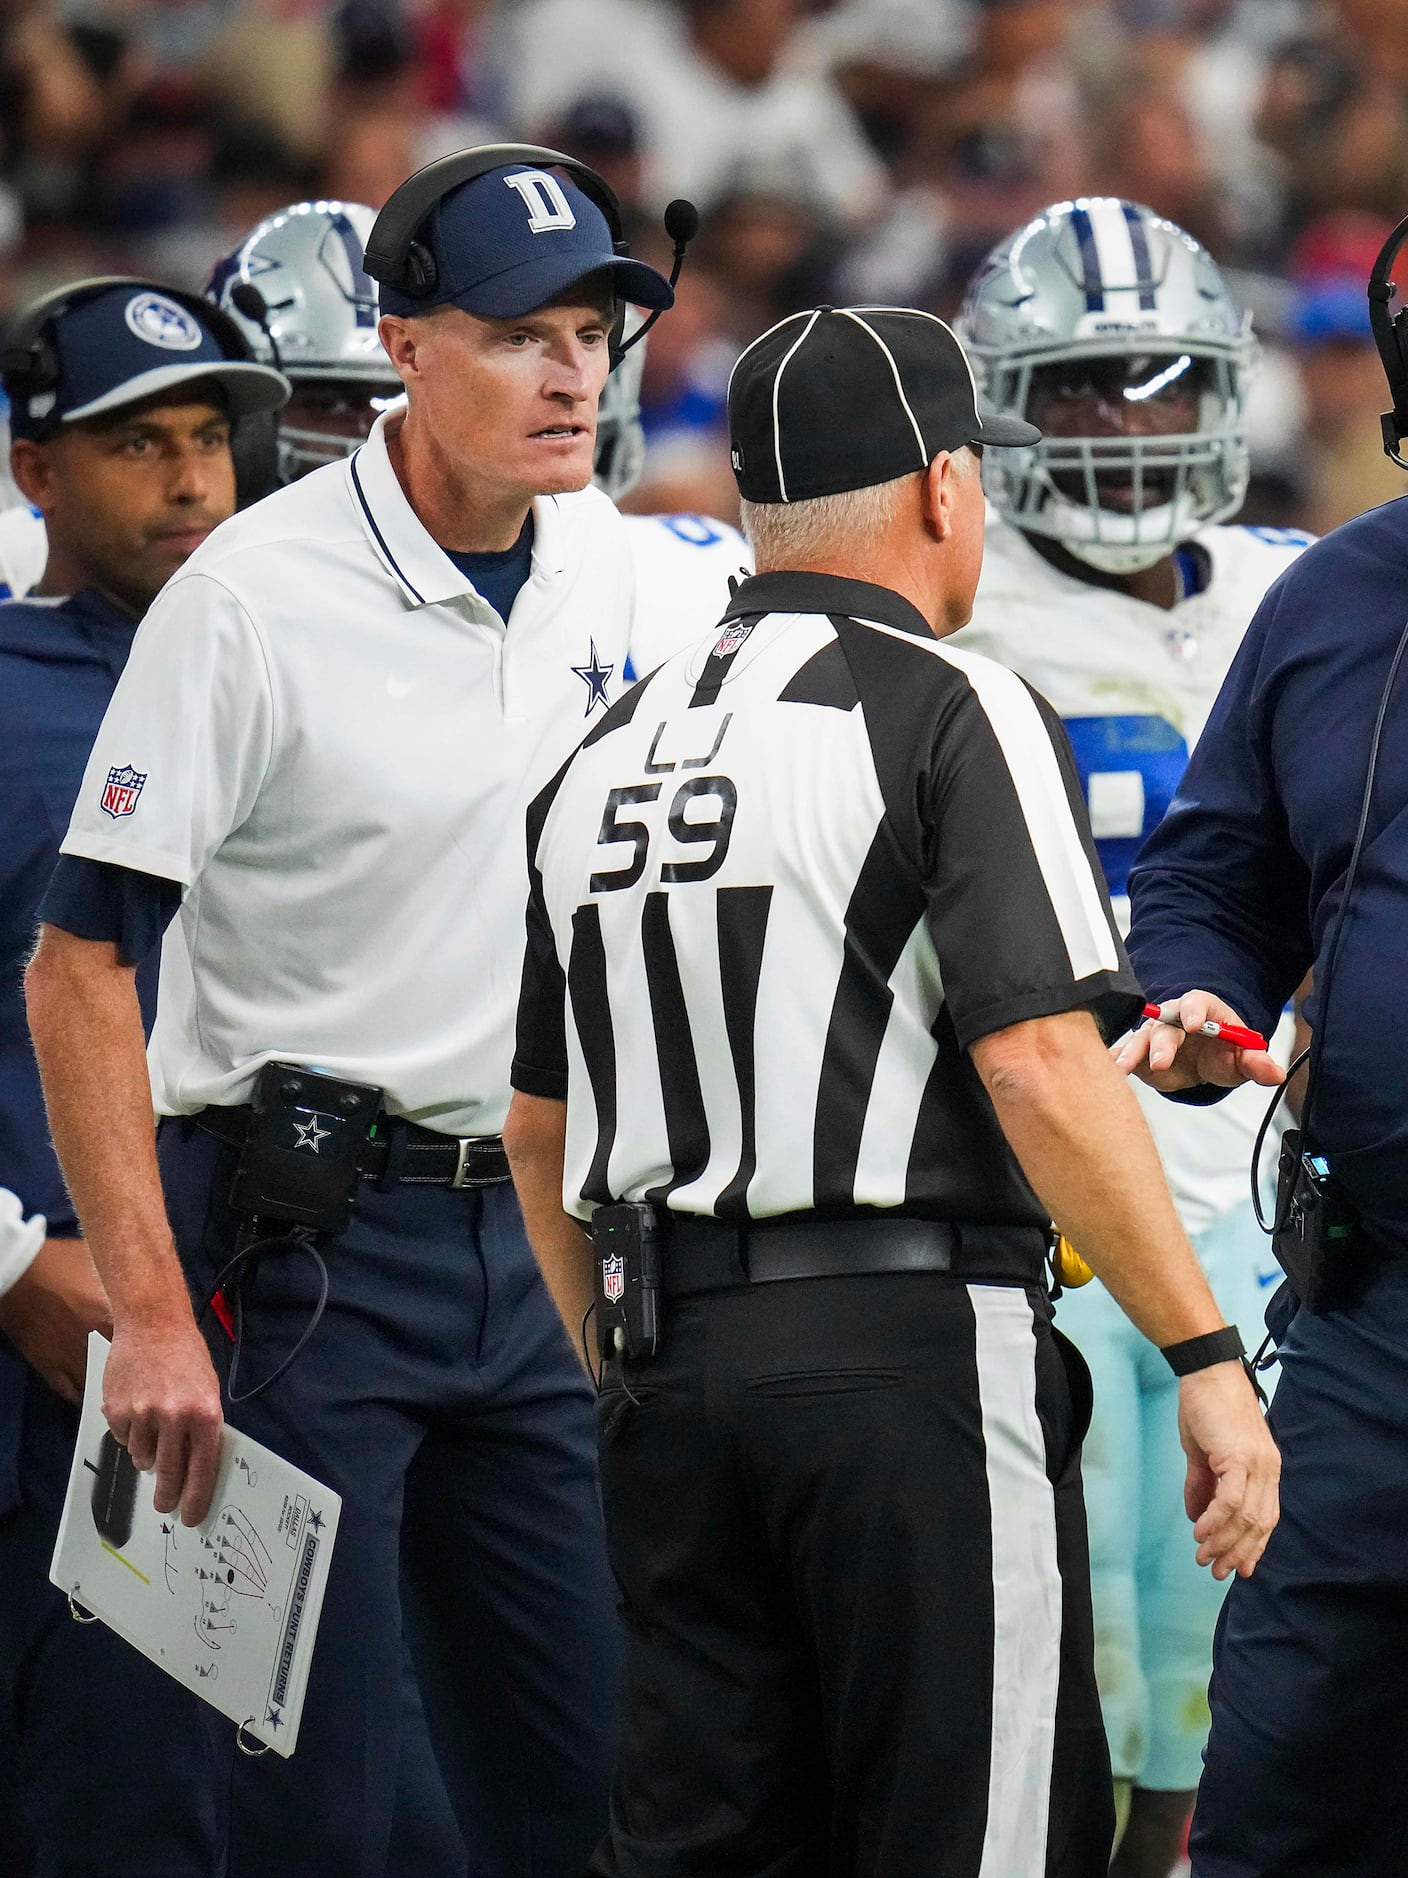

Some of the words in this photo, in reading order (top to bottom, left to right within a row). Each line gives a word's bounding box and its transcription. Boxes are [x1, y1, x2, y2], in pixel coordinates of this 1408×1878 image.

[503, 170, 577, 234] D
[716, 639, 737, 654] NFL
[643, 712, 734, 775] LJ
[104, 784, 136, 814] NFL
[588, 775, 738, 894] 59
[606, 1276, 622, 1296] NFL
[290, 1507, 302, 1538] DALLAS
[296, 1539, 316, 1602] COWBOYS
[287, 1604, 302, 1640] PUNT
[276, 1642, 294, 1702] RETURNS
